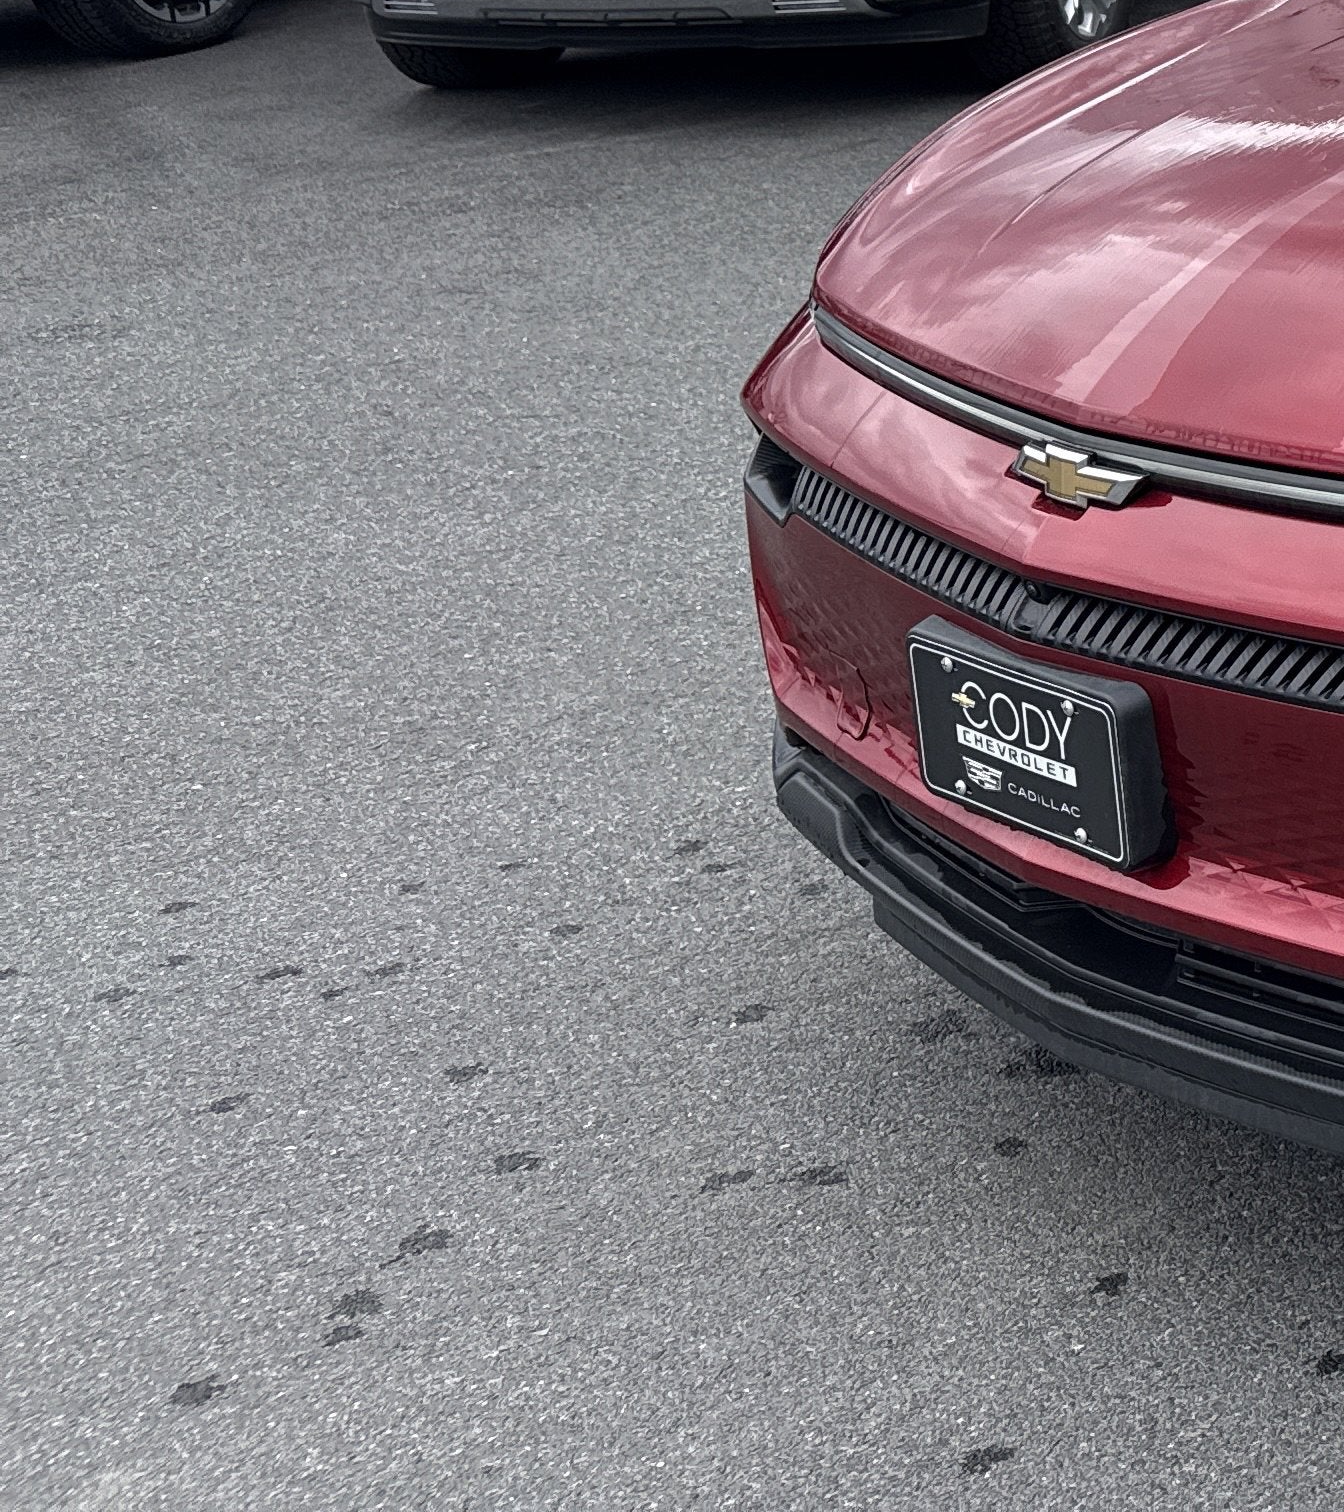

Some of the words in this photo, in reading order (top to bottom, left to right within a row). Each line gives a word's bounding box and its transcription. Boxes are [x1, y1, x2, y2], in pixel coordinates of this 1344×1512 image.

[954, 681, 1072, 760] CODY
[962, 729, 1070, 781] CHEVROLET
[1007, 781, 1081, 818] CADILLAC
